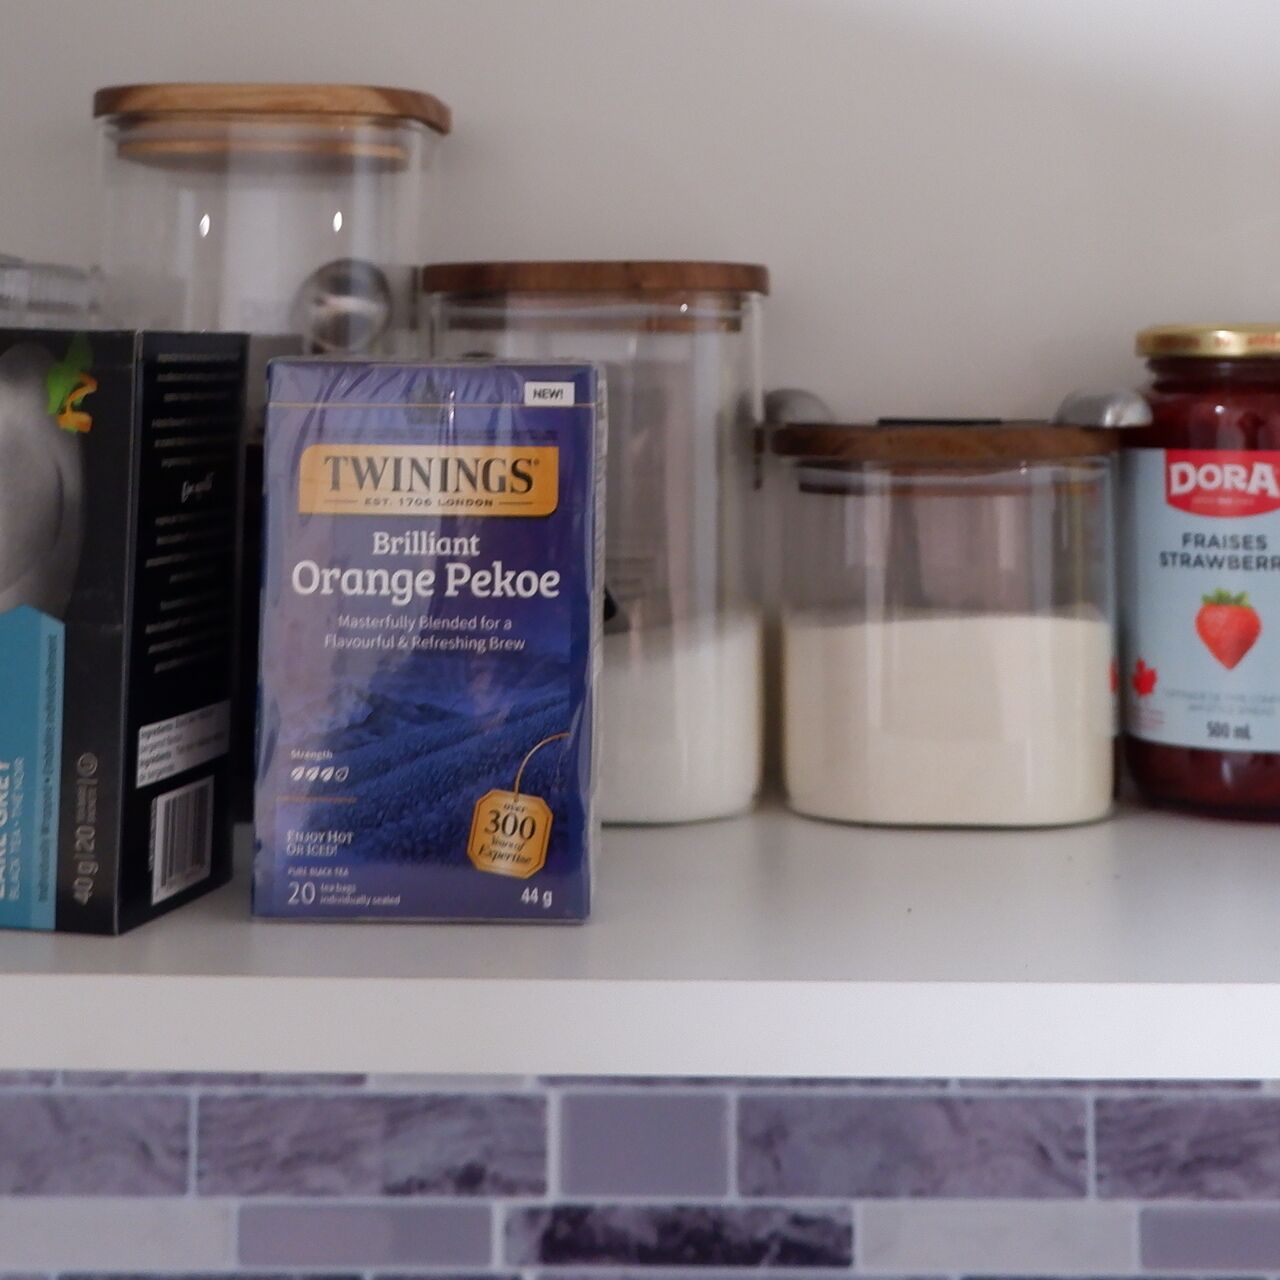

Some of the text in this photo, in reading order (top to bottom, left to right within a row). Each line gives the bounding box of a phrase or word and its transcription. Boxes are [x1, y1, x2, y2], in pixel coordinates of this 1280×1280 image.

[532, 389, 564, 401] NEW!
[324, 455, 535, 495] TWININGS
[399, 497, 432, 508] 1706
[437, 498, 494, 509] LONDON
[372, 531, 481, 556] Brilliant
[1181, 531, 1268, 551] FRAISES
[292, 559, 561, 606] Orange Pekoe
[338, 614, 513, 633] Masterfully Blended for a
[324, 634, 526, 653] Flavourful & Refreshing Brew
[290, 748, 333, 762] Strength
[484, 808, 537, 841] 300
[74, 824, 96, 853] 20
[287, 881, 316, 904] 20
[520, 886, 553, 909] 44 g
